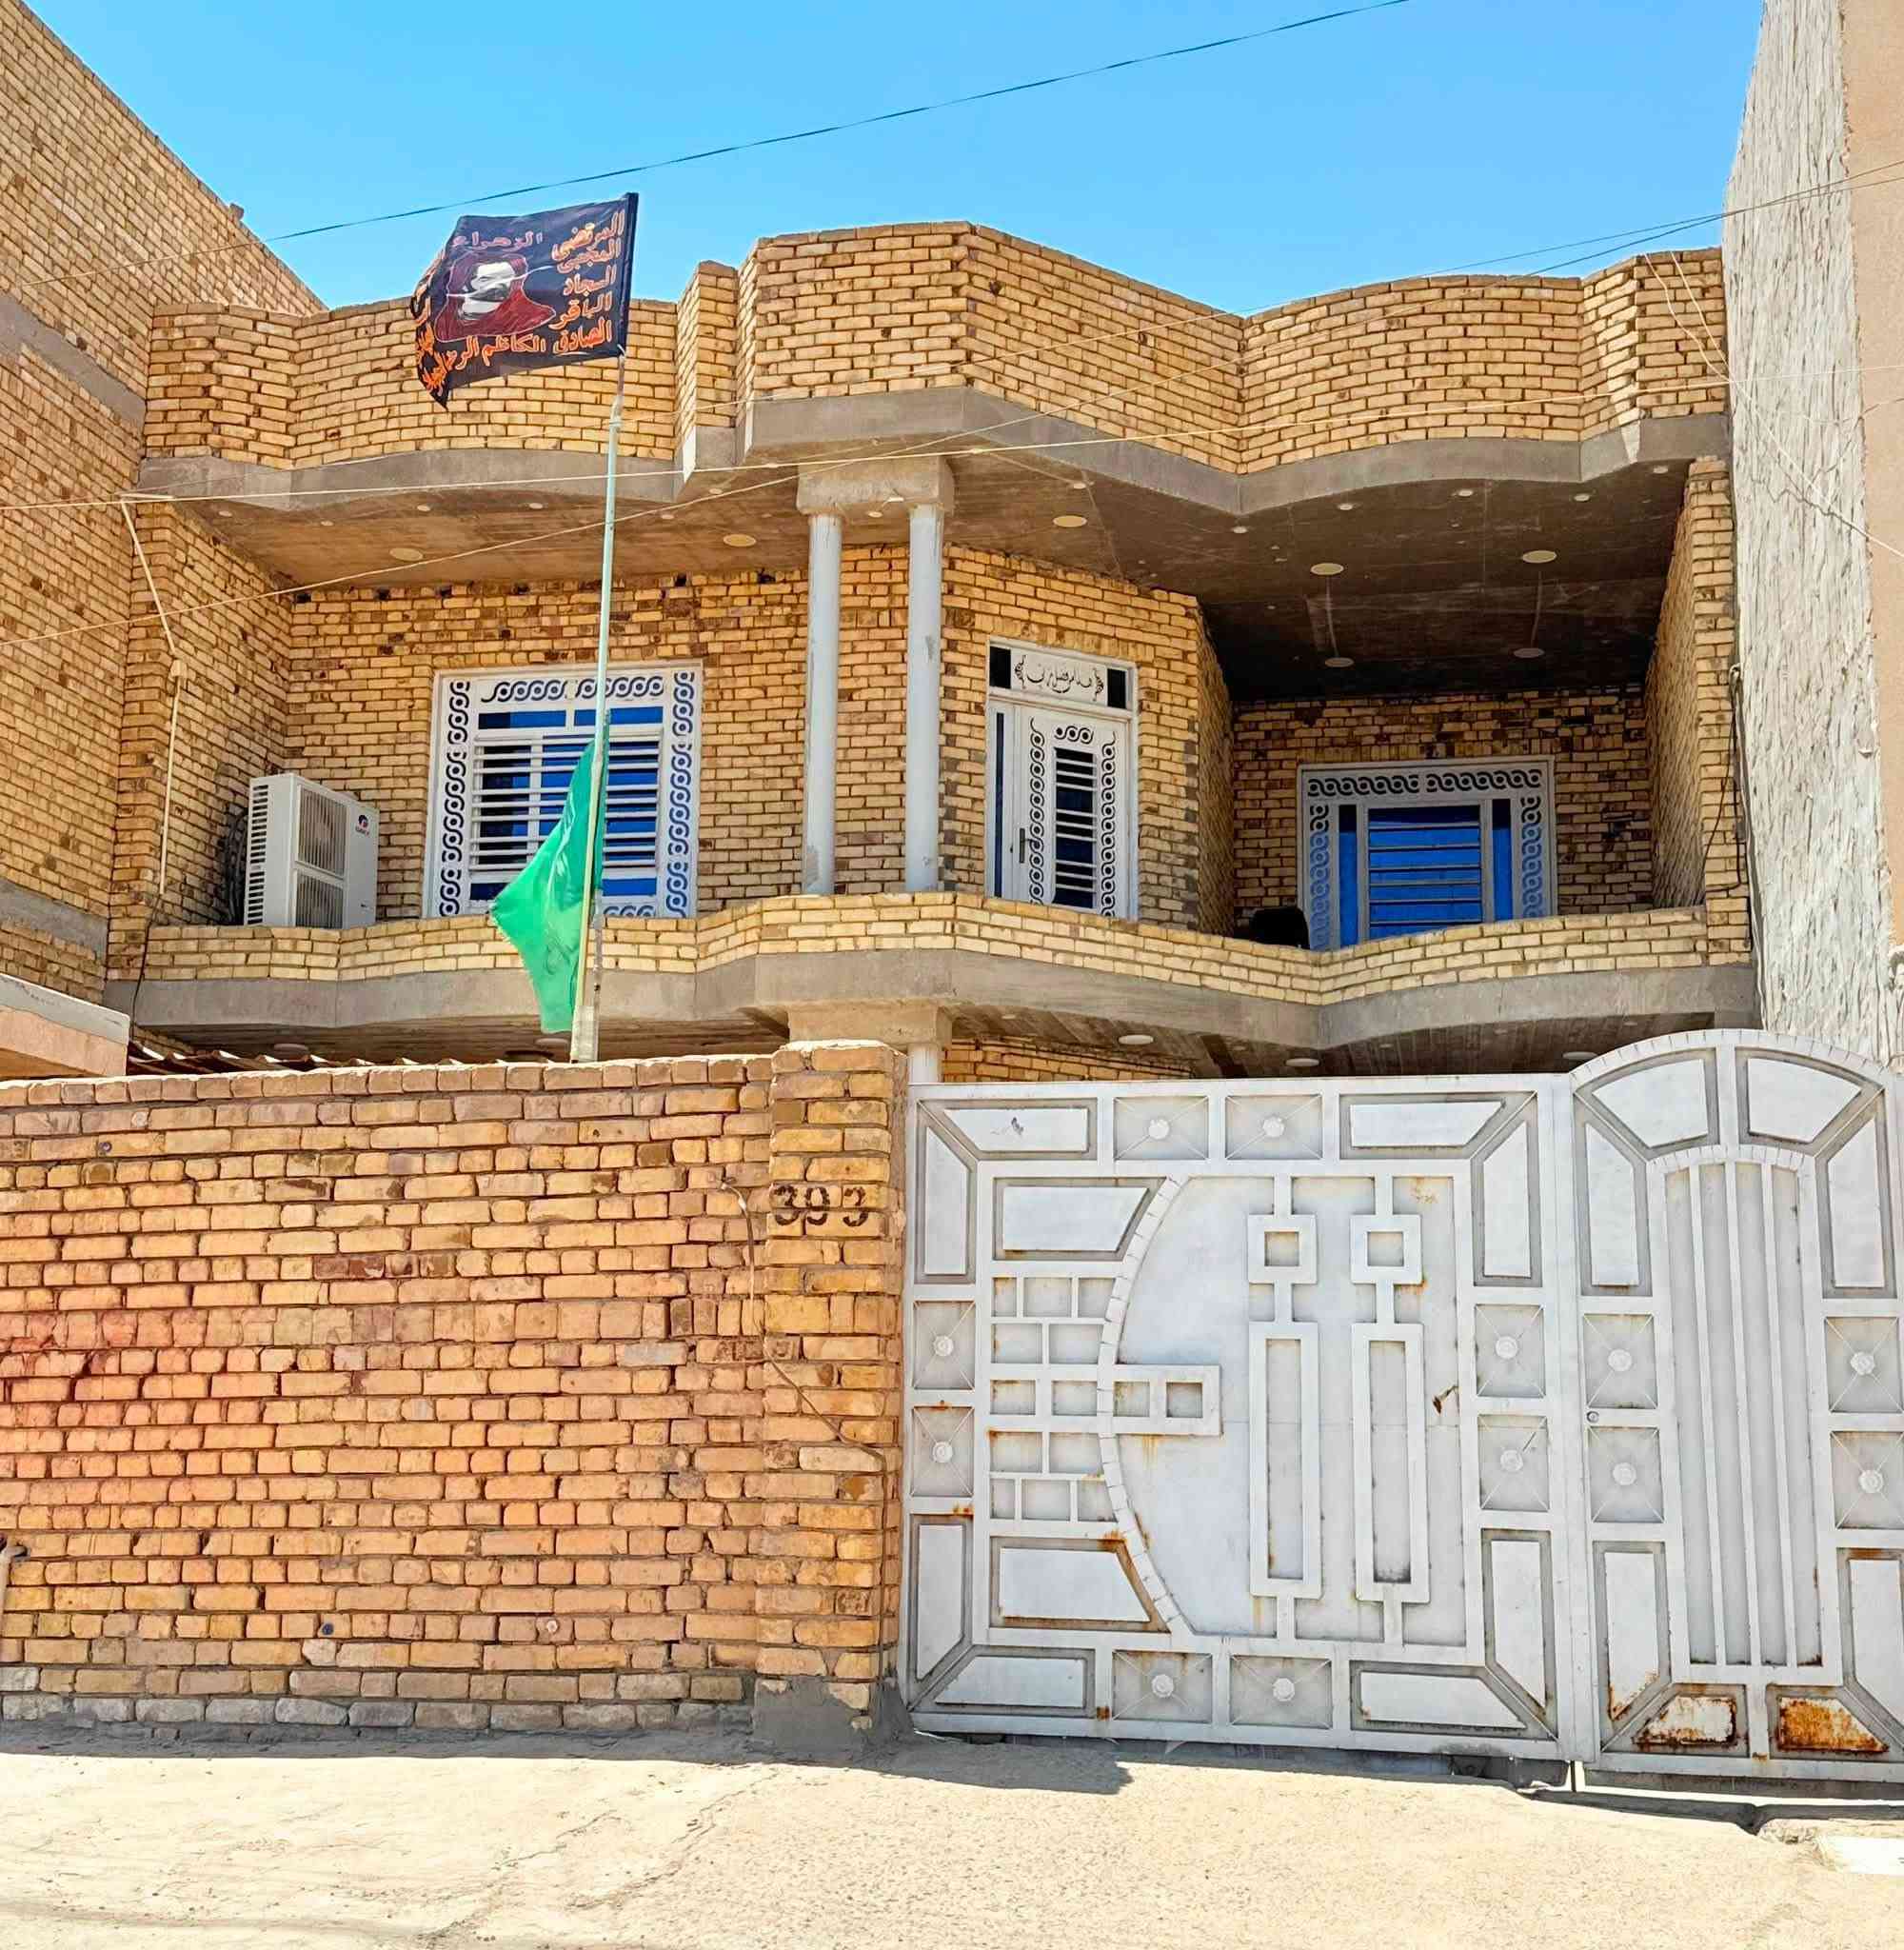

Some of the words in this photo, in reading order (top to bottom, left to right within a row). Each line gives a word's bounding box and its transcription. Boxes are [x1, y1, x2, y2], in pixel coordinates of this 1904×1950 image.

[548, 290, 613, 330] الباقر
[481, 333, 545, 366] الكاظم
[552, 316, 613, 354] الصادق
[773, 1185, 869, 1227] 393
